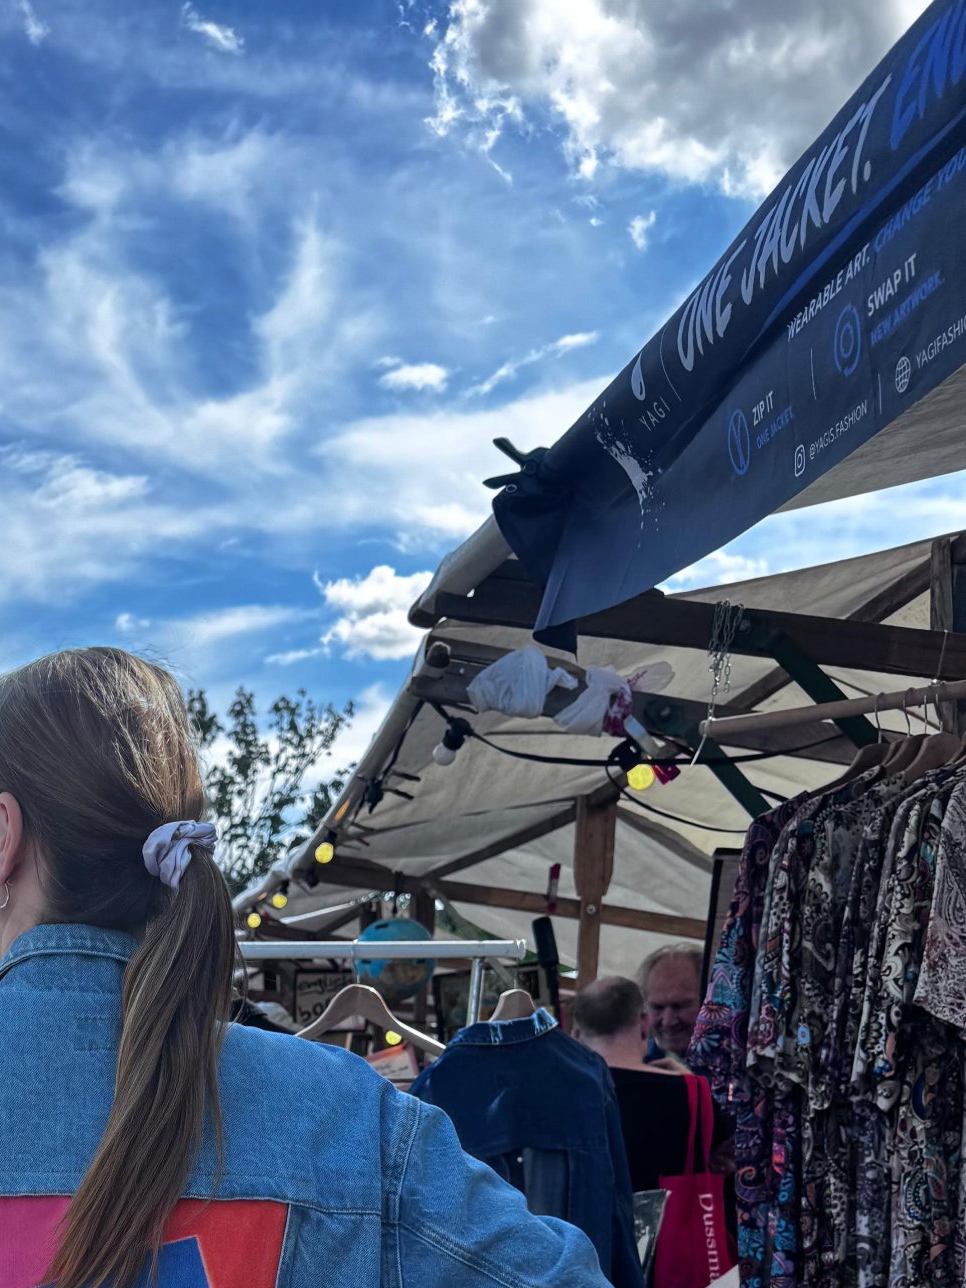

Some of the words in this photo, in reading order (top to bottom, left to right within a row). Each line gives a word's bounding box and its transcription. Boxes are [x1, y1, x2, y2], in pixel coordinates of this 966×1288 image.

[677, 240, 746, 371] ONE
[741, 73, 892, 305] JACKET.
[787, 271, 845, 342] WEARABLE
[845, 243, 871, 285] ART.
[874, 178, 933, 253] CHANGE
[867, 269, 902, 317] SWAP
[904, 253, 916, 282] IT
[870, 315, 892, 346] NEW
[639, 397, 671, 431] YAGI
[752, 400, 765, 426] ZIP
[766, 390, 774, 413] IT
[809, 399, 868, 460] @YAGIS.FASHION
[756, 428, 769, 449] ONE
